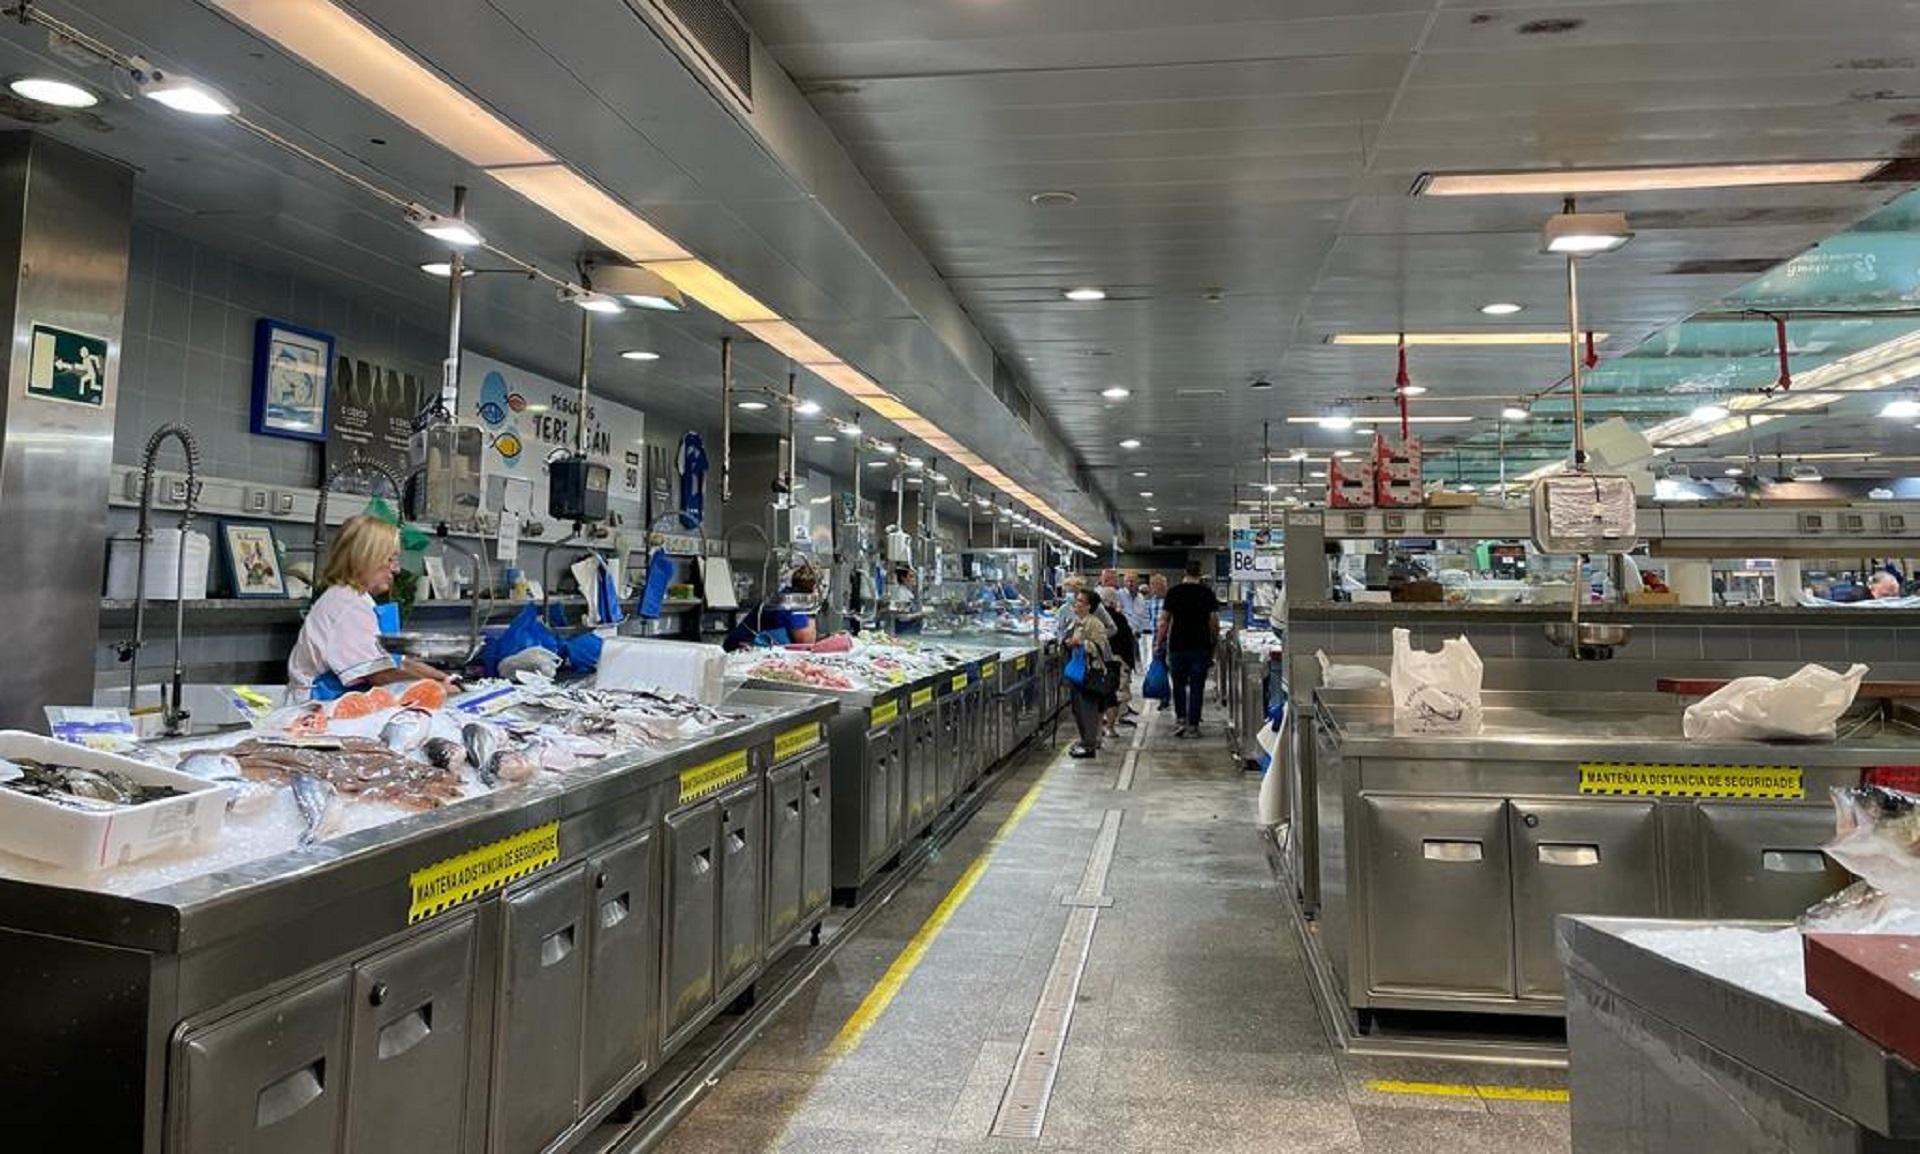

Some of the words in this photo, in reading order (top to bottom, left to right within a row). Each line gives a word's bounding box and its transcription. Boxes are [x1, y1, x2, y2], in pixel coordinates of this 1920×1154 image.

[1588, 770, 1638, 784] MANTEÑA
[1640, 774, 1648, 784] A
[1650, 774, 1706, 786] DISTANCIA
[1708, 775, 1721, 787] DE
[1724, 776, 1794, 789] SEGURIDADE
